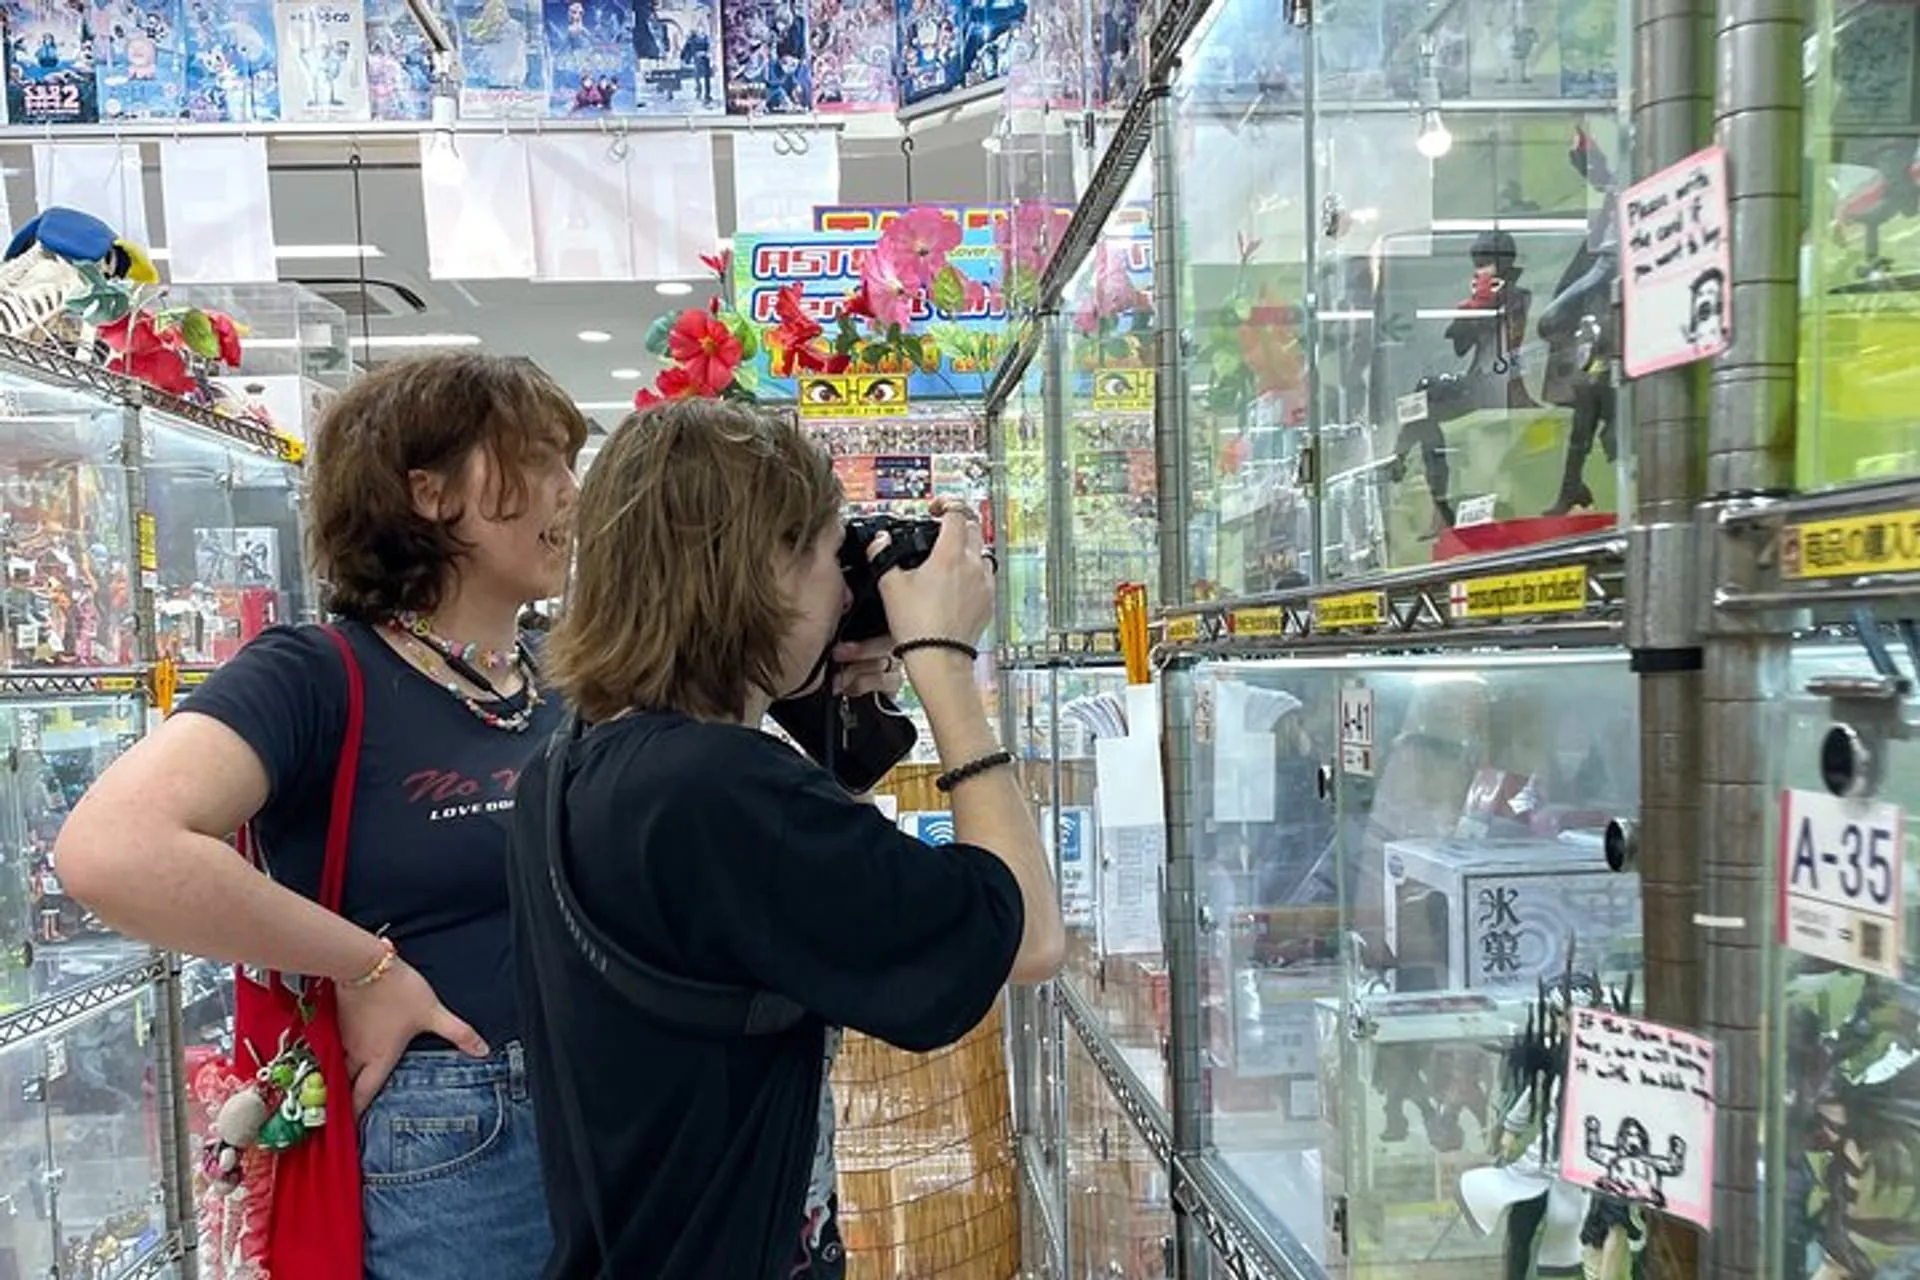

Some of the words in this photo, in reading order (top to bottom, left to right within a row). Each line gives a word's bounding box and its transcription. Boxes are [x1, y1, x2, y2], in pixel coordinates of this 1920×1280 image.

[429, 802, 481, 820] LOVE
[1791, 815, 1893, 905] A-35
[1480, 887, 1523, 972] 氷菓
